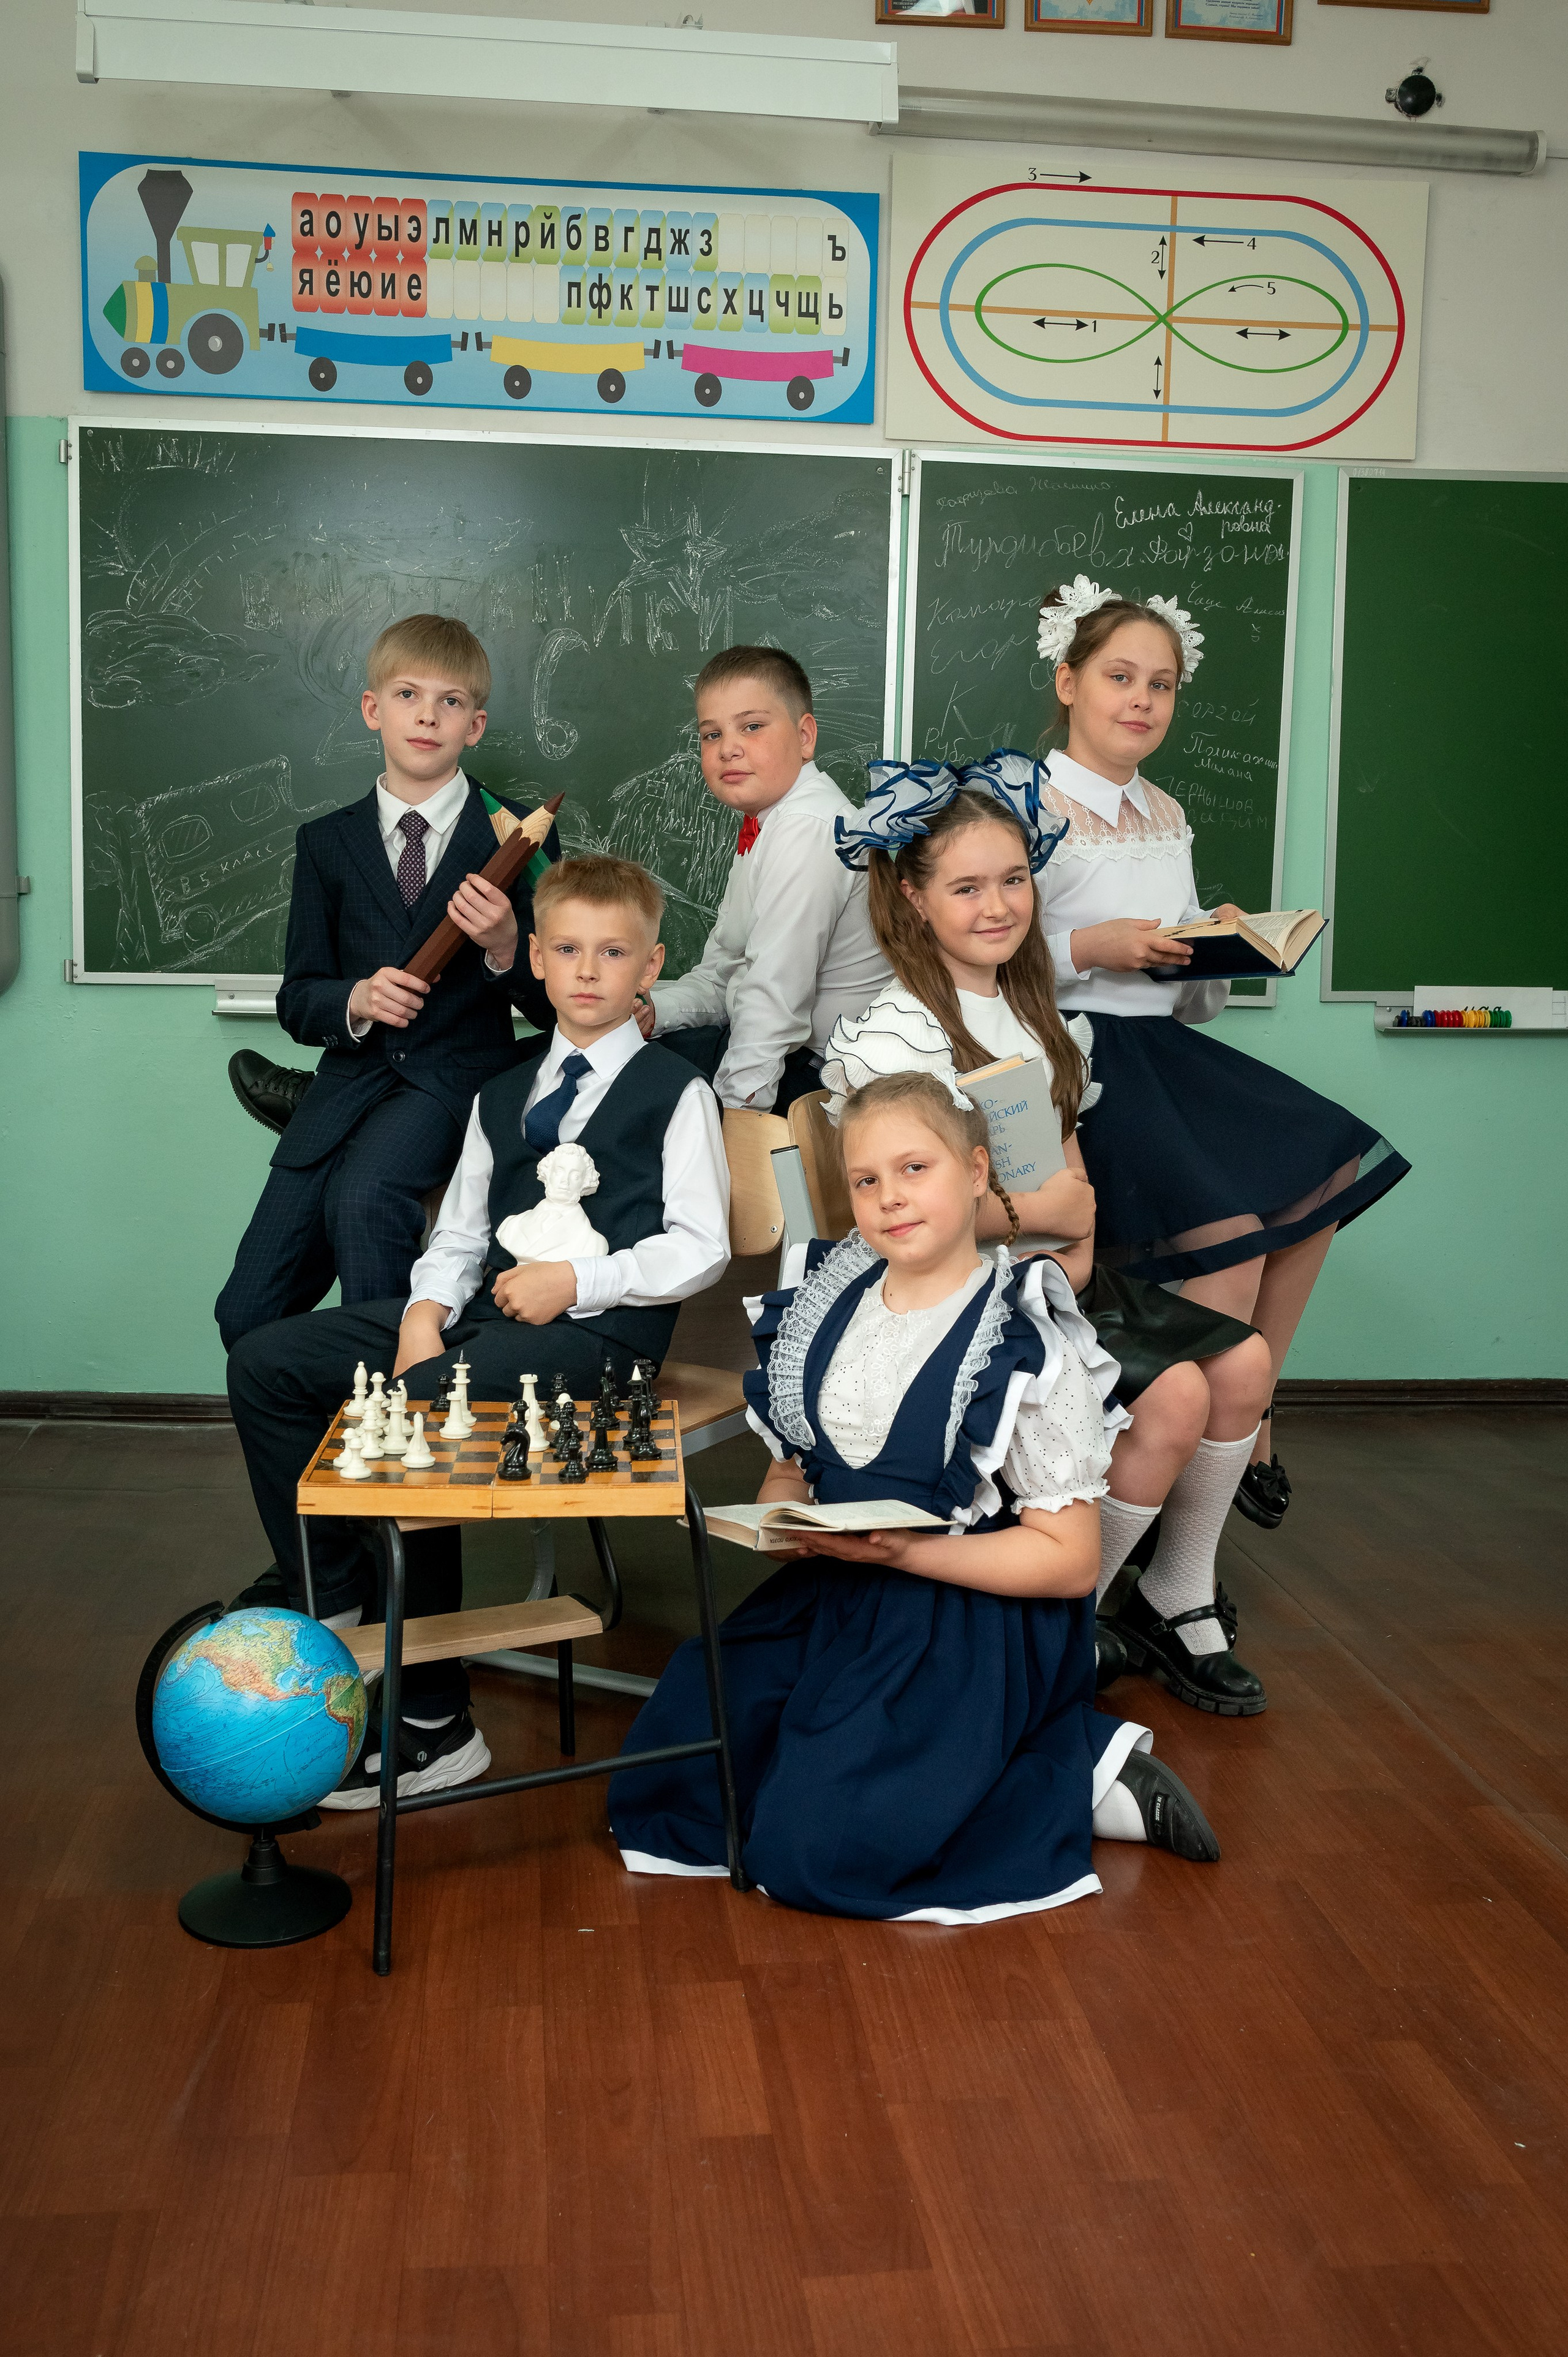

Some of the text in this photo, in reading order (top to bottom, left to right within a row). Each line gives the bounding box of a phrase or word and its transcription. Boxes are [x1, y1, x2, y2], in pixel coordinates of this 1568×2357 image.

[1028, 167, 1037, 181] 3
[1246, 237, 1257, 250] 4
[1151, 251, 1160, 264] 2
[1267, 282, 1276, 295] 5
[1091, 320, 1097, 333] 1
[1115, 496, 1181, 529] Елена
[930, 633, 1029, 674] Егор
[199, 871, 210, 888] 5
[989, 1099, 1029, 1123] ЙСКИЙ
[998, 1161, 1036, 1183] ONARY
